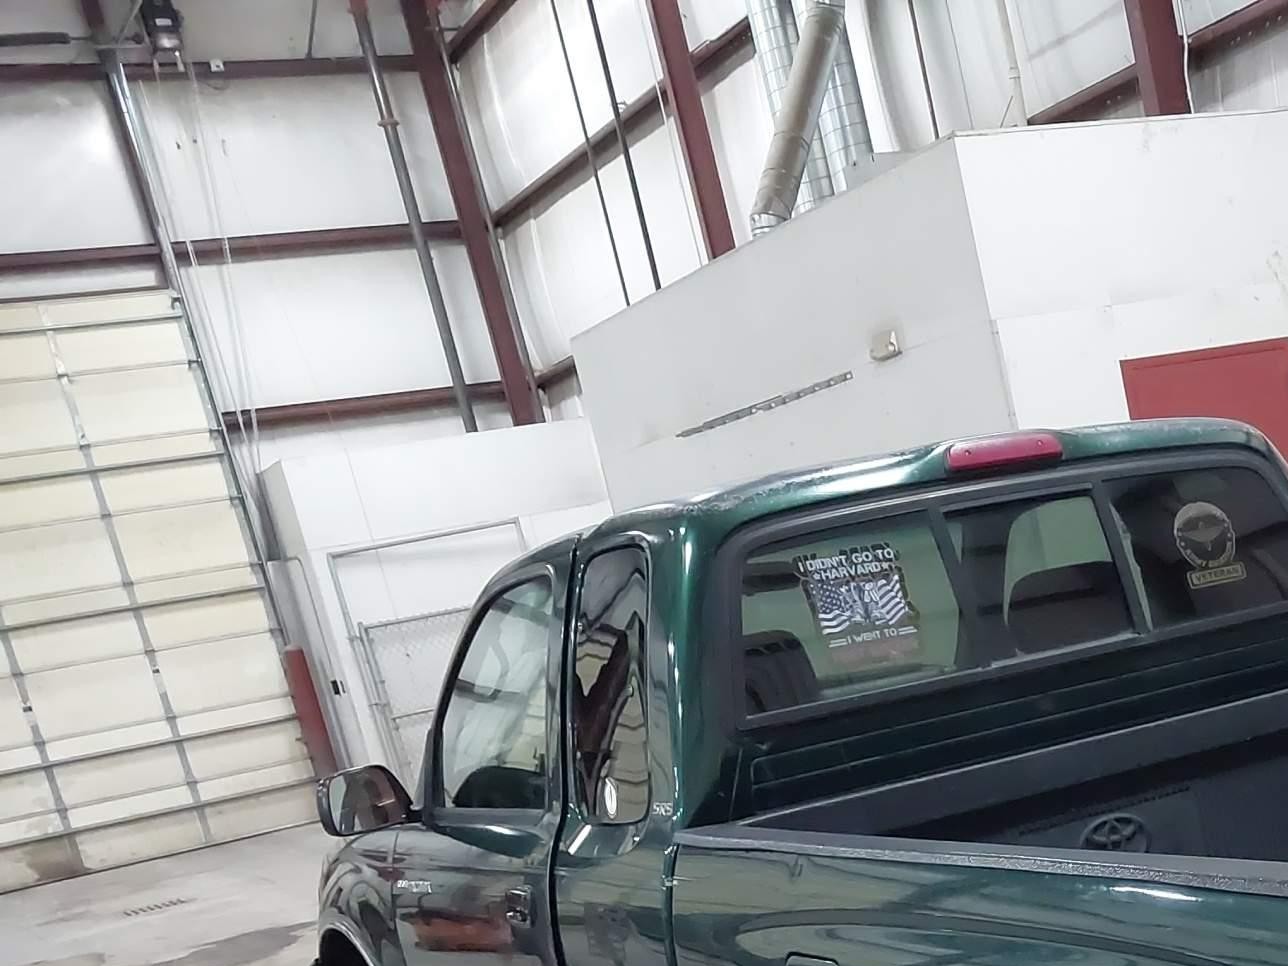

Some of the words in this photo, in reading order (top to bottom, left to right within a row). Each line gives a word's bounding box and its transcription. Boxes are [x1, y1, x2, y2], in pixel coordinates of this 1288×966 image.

[806, 555, 847, 571] DIDN'T
[852, 552, 872, 564] GO
[876, 548, 894, 559] TO
[821, 562, 880, 580] HARVARD
[853, 630, 881, 642] WENT
[884, 628, 897, 638] TO
